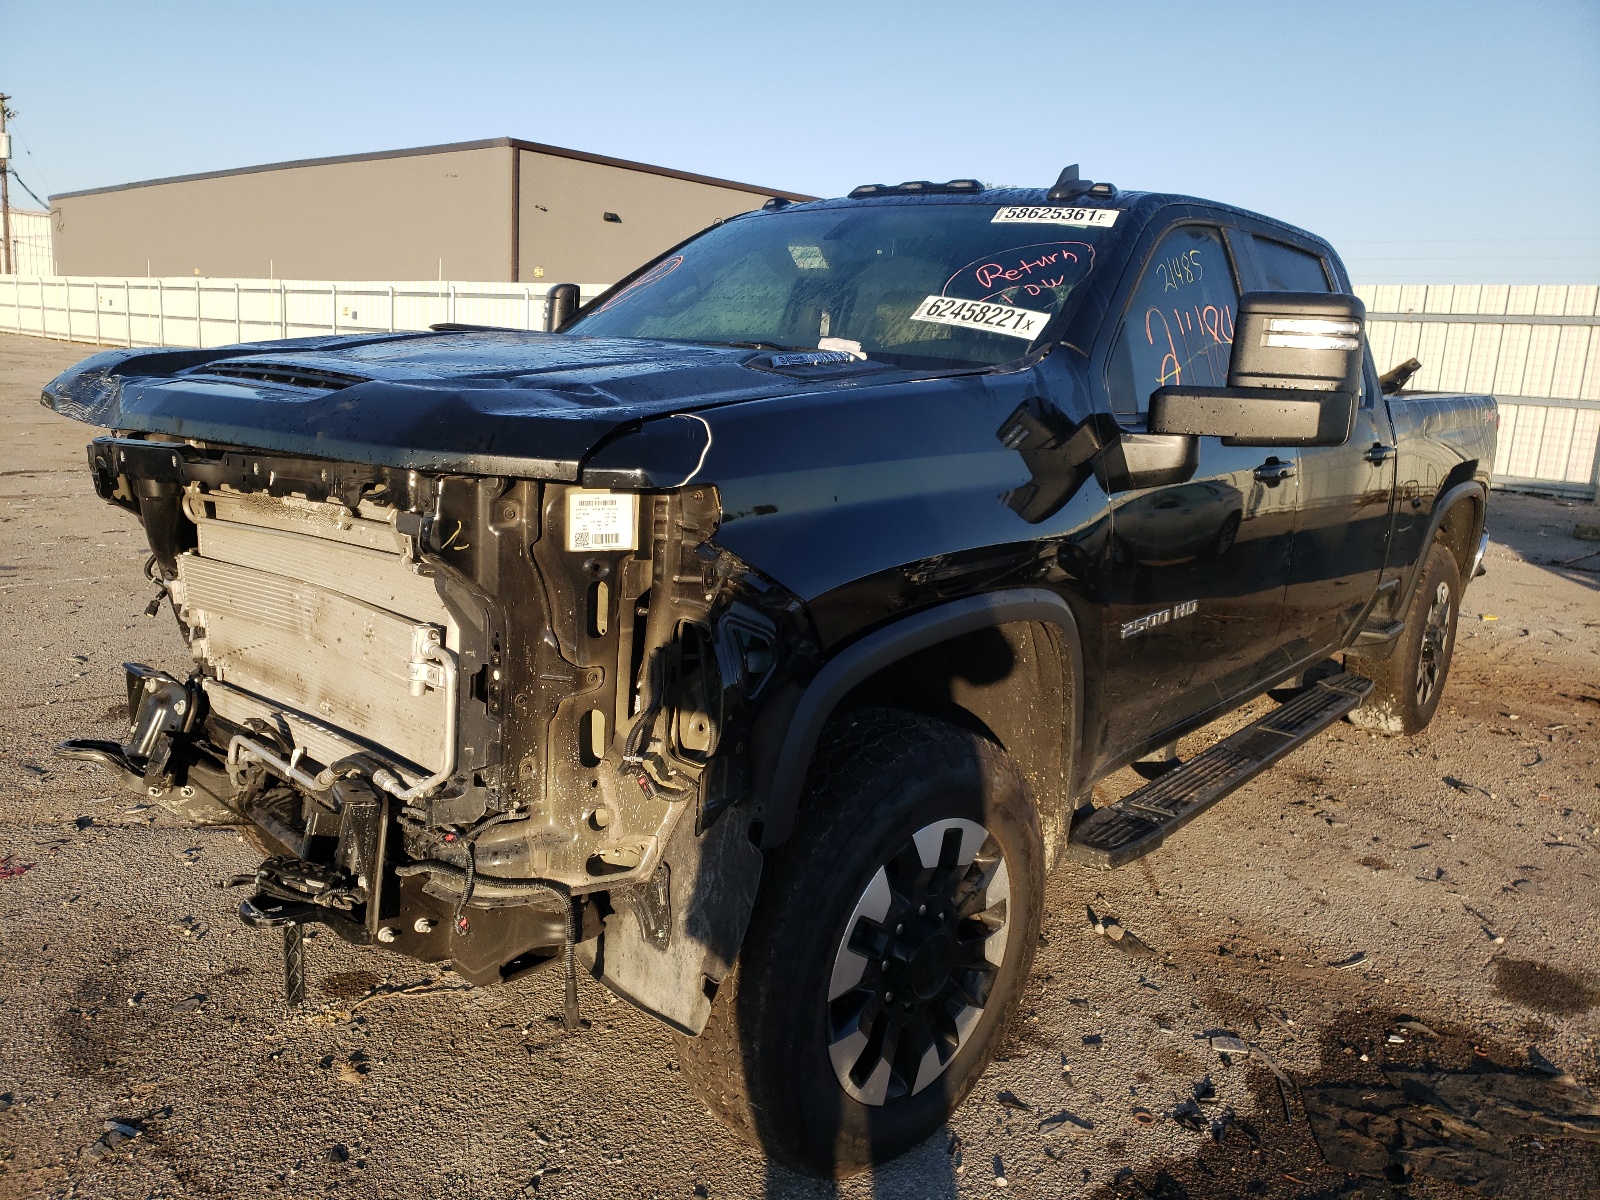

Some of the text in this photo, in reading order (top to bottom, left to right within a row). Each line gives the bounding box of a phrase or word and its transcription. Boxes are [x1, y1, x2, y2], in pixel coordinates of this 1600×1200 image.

[976, 249, 1078, 288] Return
[1156, 250, 1203, 293] 21485
[1120, 599, 1199, 639] 2500 HD
